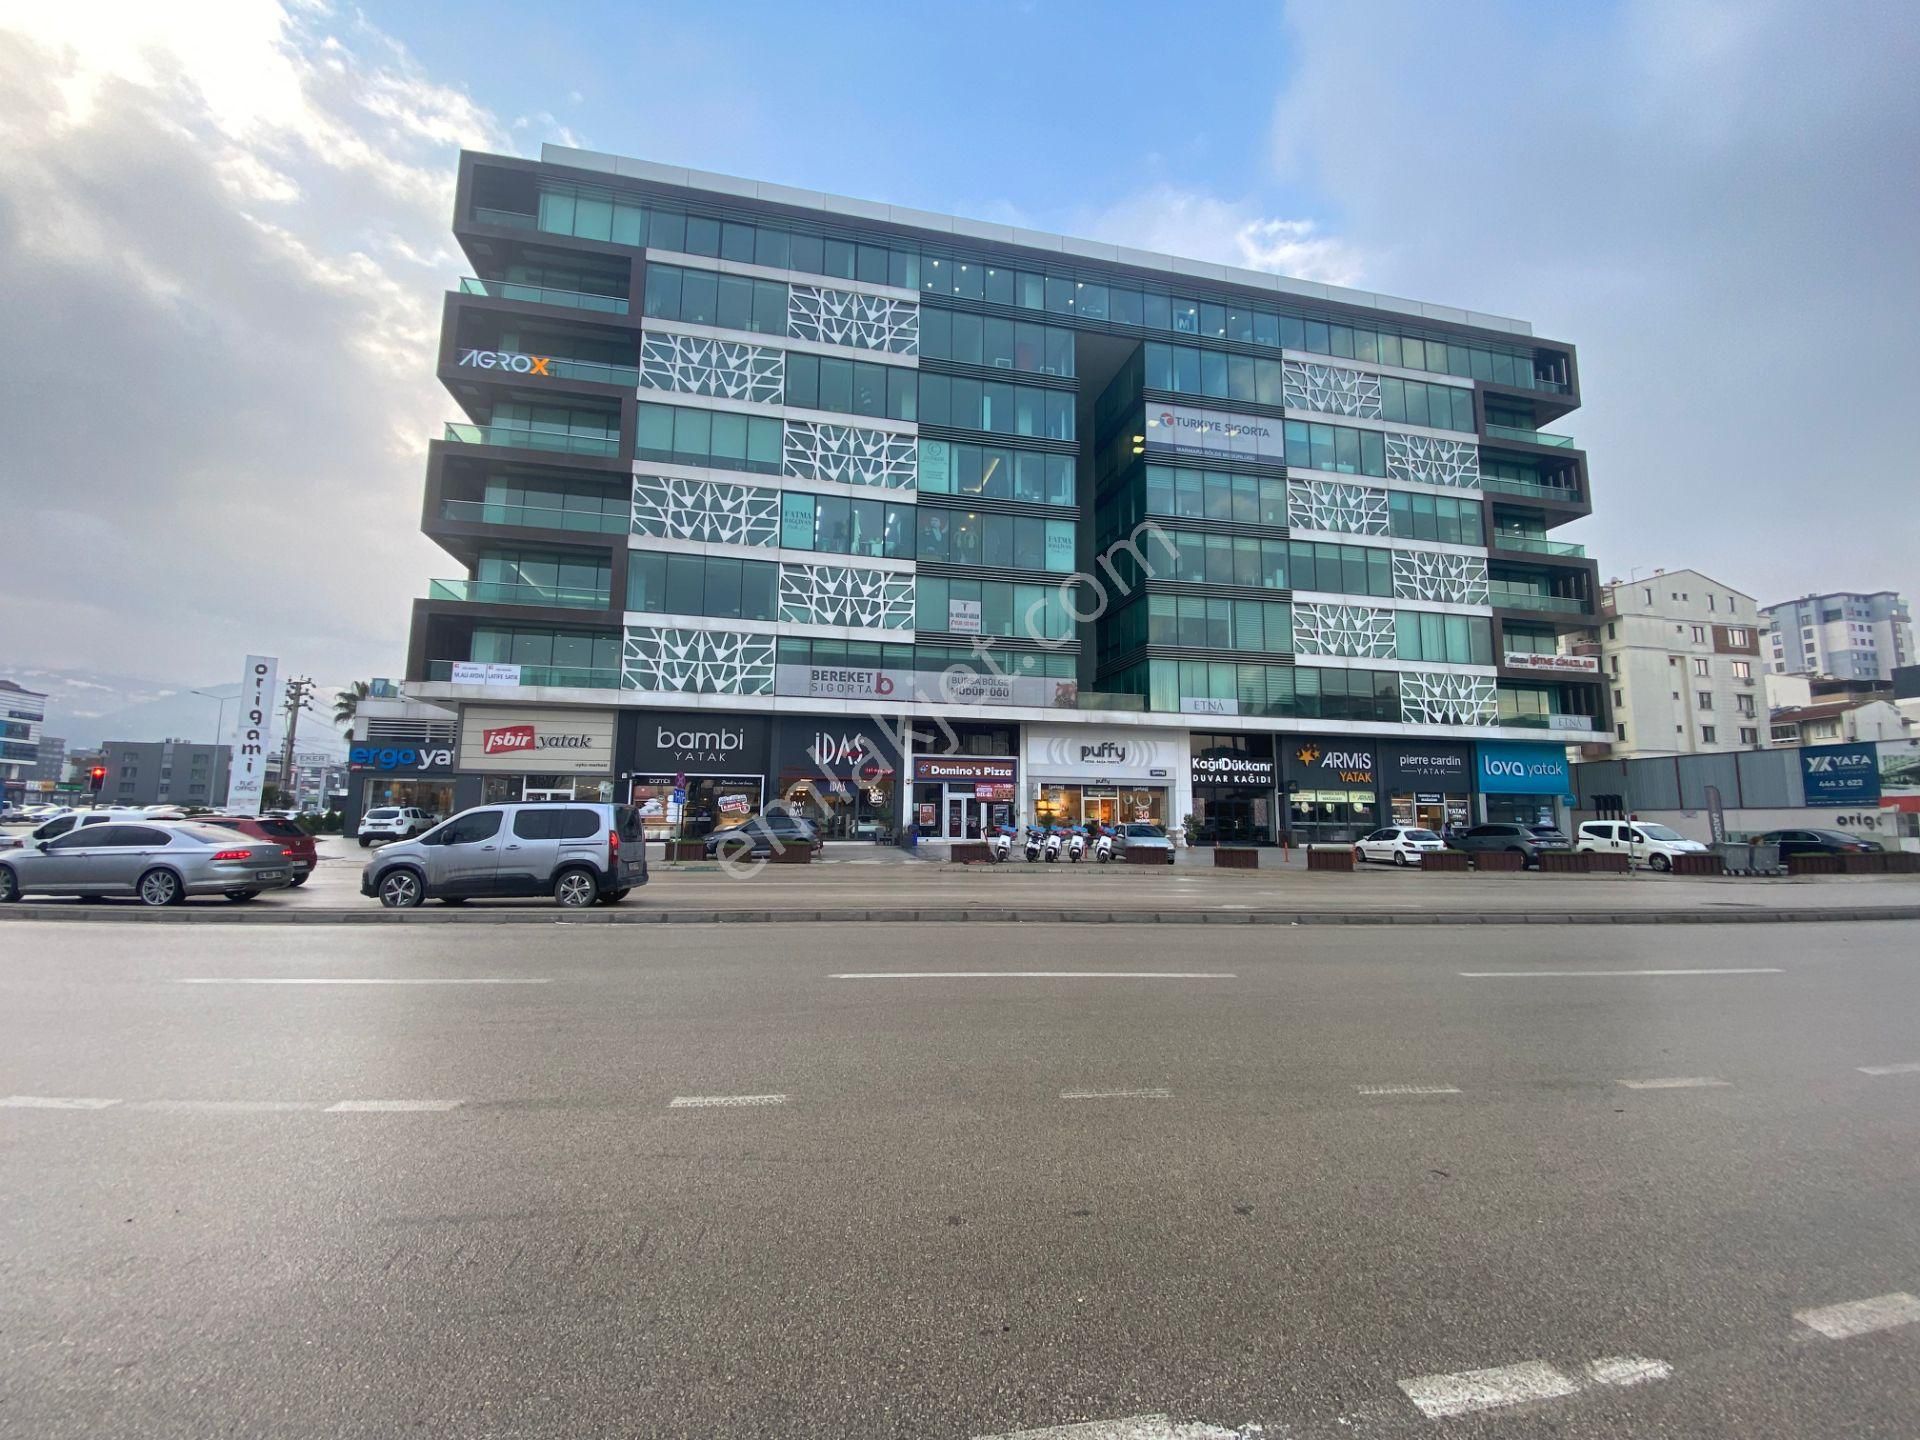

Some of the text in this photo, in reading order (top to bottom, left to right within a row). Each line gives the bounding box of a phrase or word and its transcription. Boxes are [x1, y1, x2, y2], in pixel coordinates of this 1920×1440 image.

[459, 350, 549, 375] AGROX
[811, 670, 873, 685] BEREKET
[242, 664, 268, 773] origami
[537, 735, 592, 750] yatak
[656, 727, 743, 750] bambi
[351, 747, 416, 768] ergo
[674, 752, 726, 762] YATAK
[1081, 742, 1126, 762] puffy
[1400, 754, 1462, 767] pierre cardin
[1484, 755, 1563, 779] lova yatak
[1832, 755, 1871, 766] YAFA
[931, 765, 1012, 776] Domino's Pizza
[1339, 771, 1373, 783] YATAK
[1416, 767, 1446, 776] YATAK
[1193, 774, 1228, 783] DUVAR
